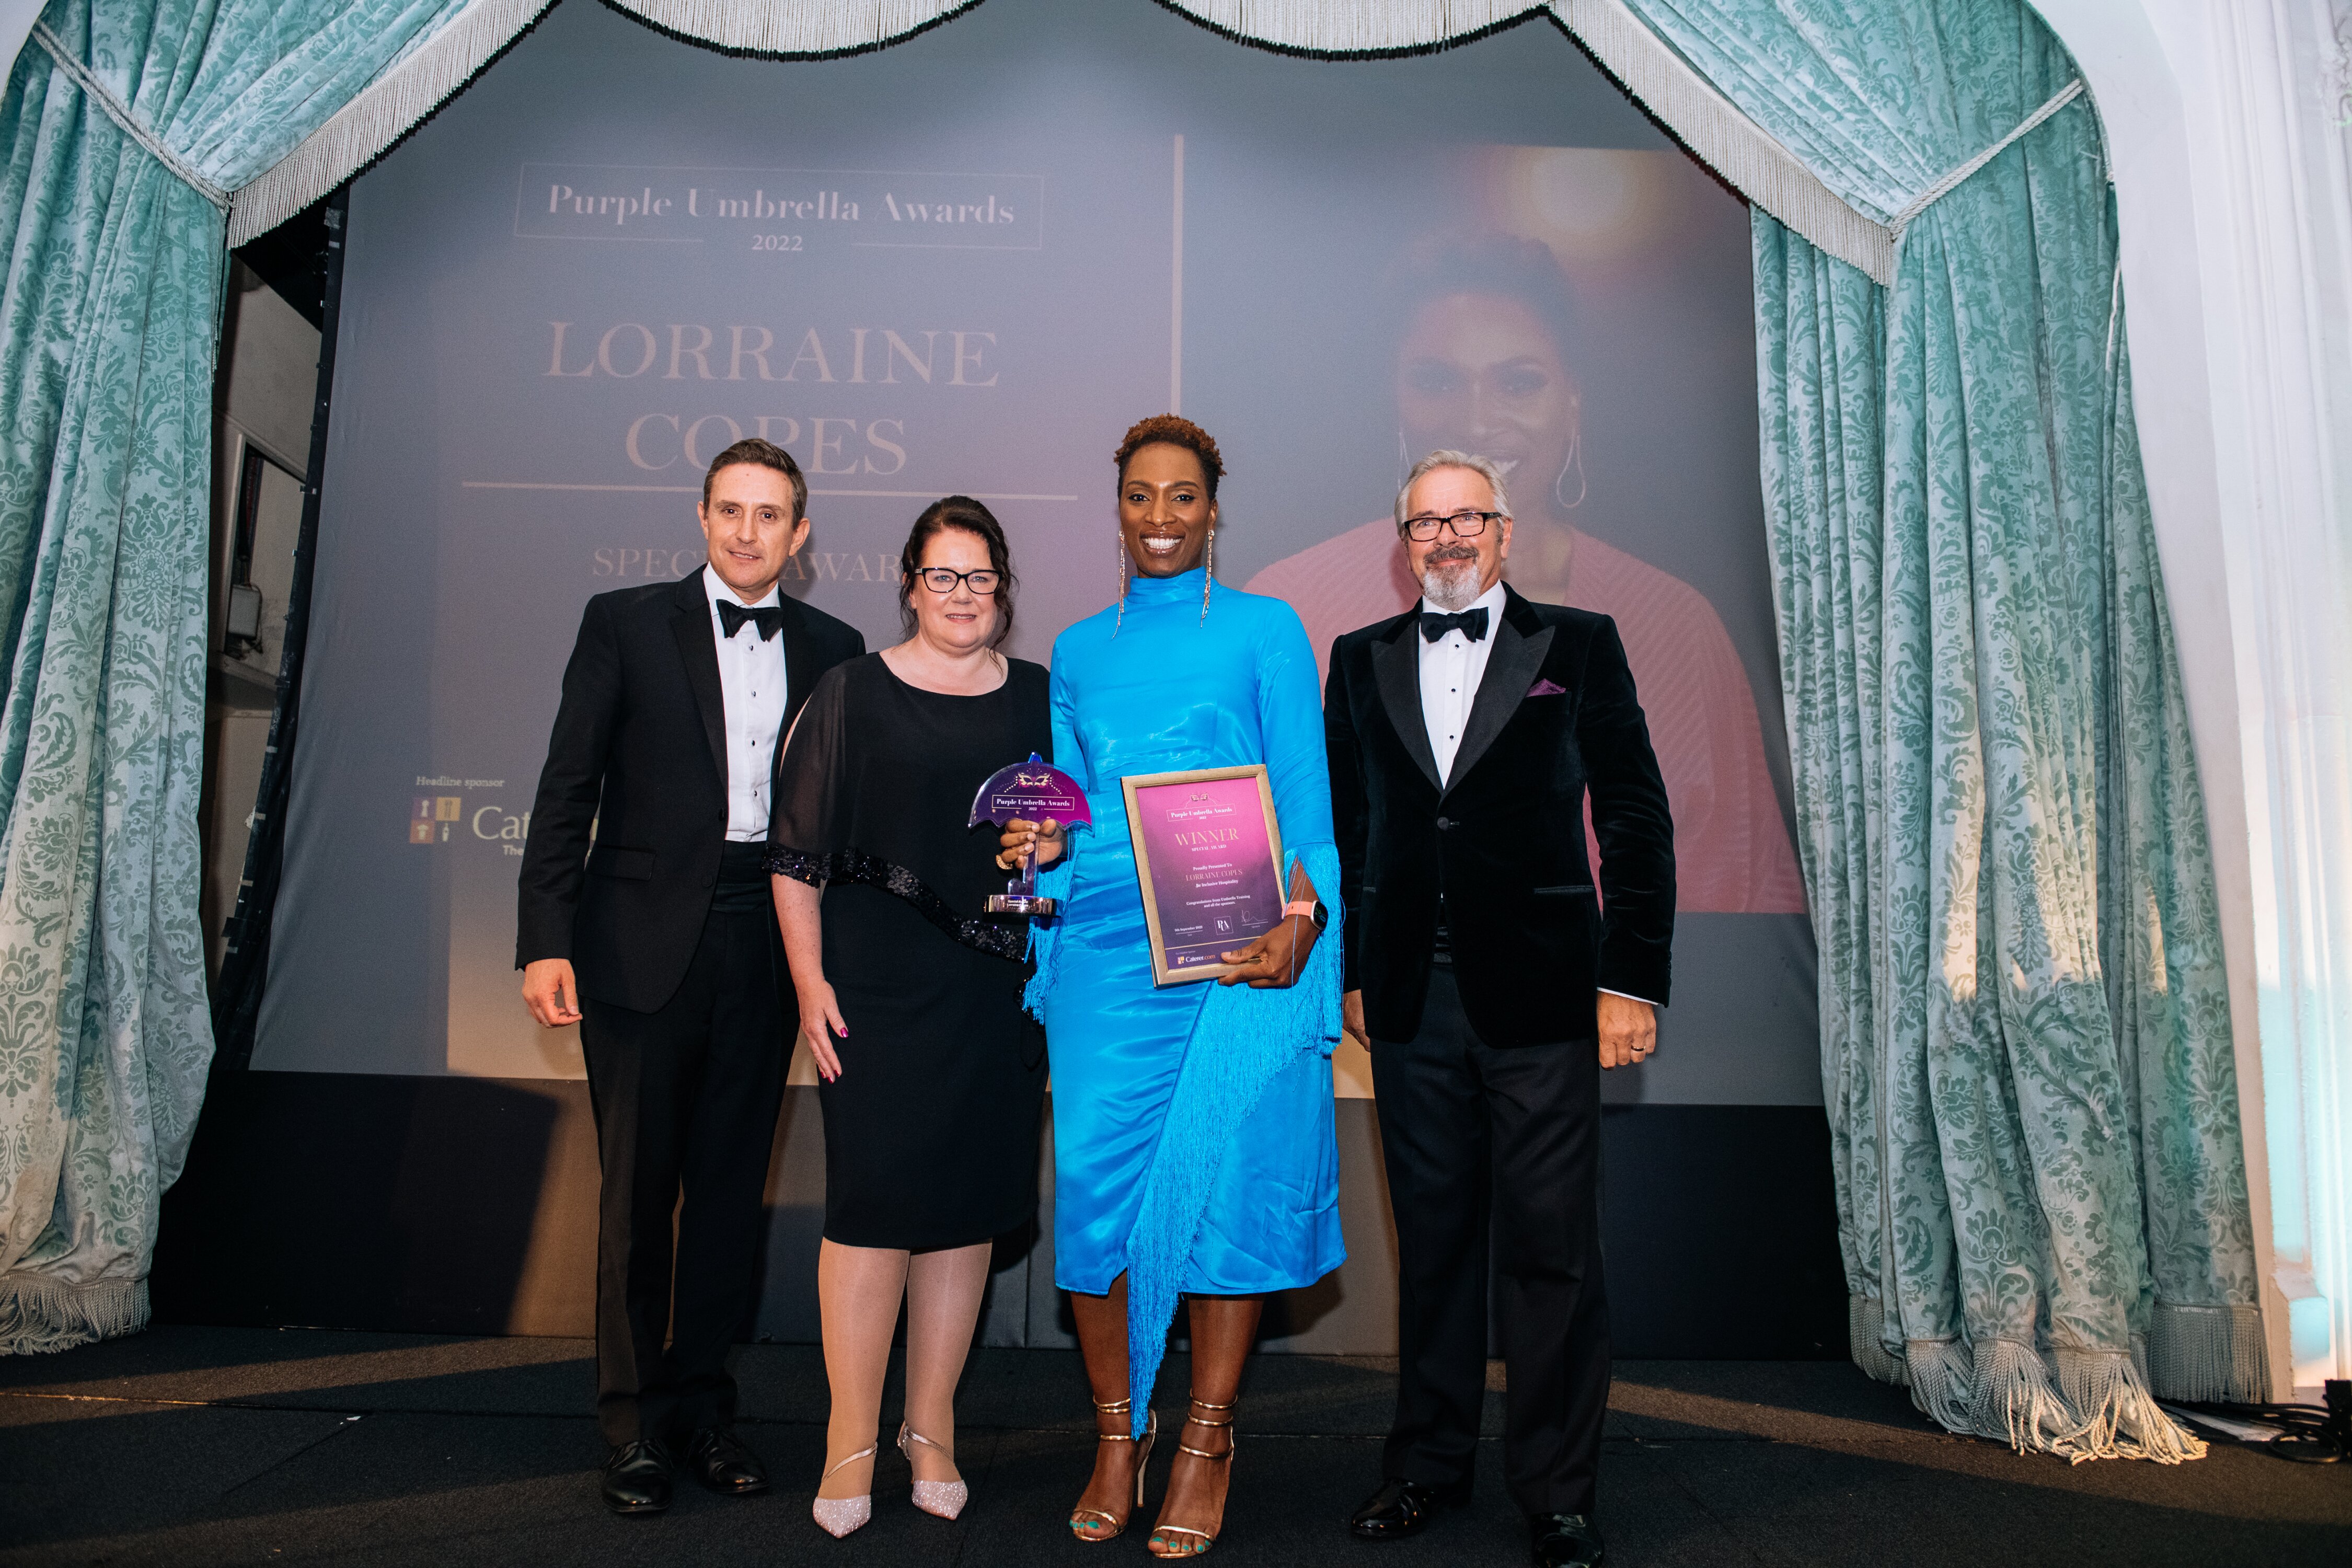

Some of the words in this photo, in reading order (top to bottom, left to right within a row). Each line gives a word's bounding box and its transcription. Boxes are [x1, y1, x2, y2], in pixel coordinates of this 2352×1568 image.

[549, 185, 672, 225] Purple
[687, 188, 859, 221] Umbrella
[874, 192, 1014, 224] Awards
[751, 234, 803, 251] 2022
[541, 321, 999, 387] LORRAINE
[780, 552, 902, 581] AWAR
[416, 776, 462, 786] Headline
[465, 779, 505, 789] sponsor
[472, 805, 531, 840] Cat
[1175, 828, 1239, 846] WINNER
[1185, 872, 1220, 881] LORRAINE
